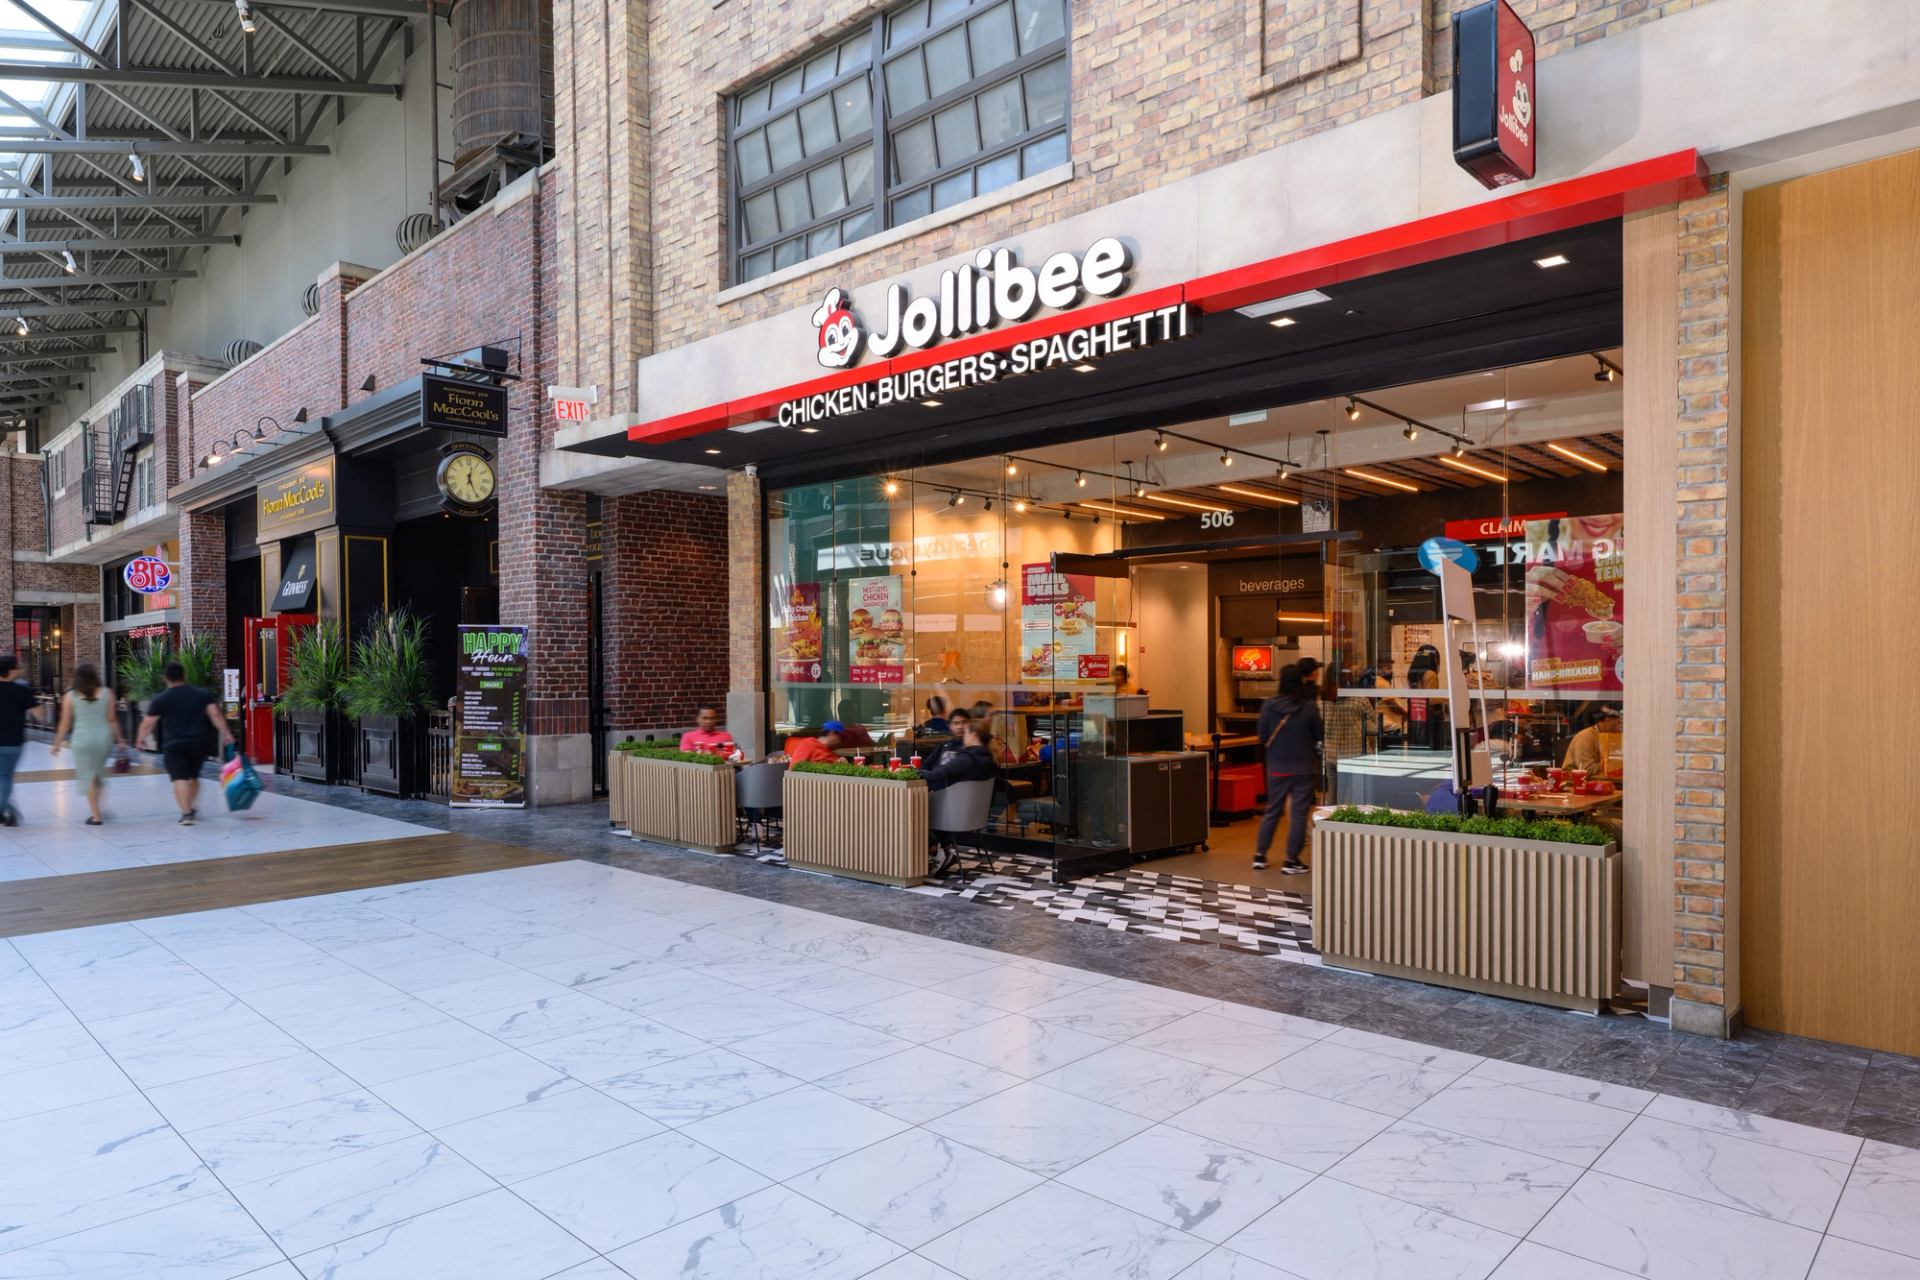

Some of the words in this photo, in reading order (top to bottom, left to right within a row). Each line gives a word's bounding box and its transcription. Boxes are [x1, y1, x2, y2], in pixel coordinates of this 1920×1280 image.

[1499, 105, 1529, 147] Jollibee
[867, 237, 1129, 358] Jollibee
[448, 392, 484, 408] Fionn
[433, 401, 500, 422] MacCool's
[557, 399, 585, 421] EXIT
[1200, 511, 1235, 530] 506
[1480, 519, 1527, 535] CLAIM
[130, 559, 169, 589] BP
[281, 579, 309, 597] GUINNESS
[1027, 583, 1070, 597] DEALS
[1239, 577, 1305, 595] beverages
[862, 593, 889, 602] CHICKEN
[463, 632, 523, 655] HAPPY
[470, 648, 515, 665] Hour
[1531, 665, 1600, 681] HAND-BREADED
